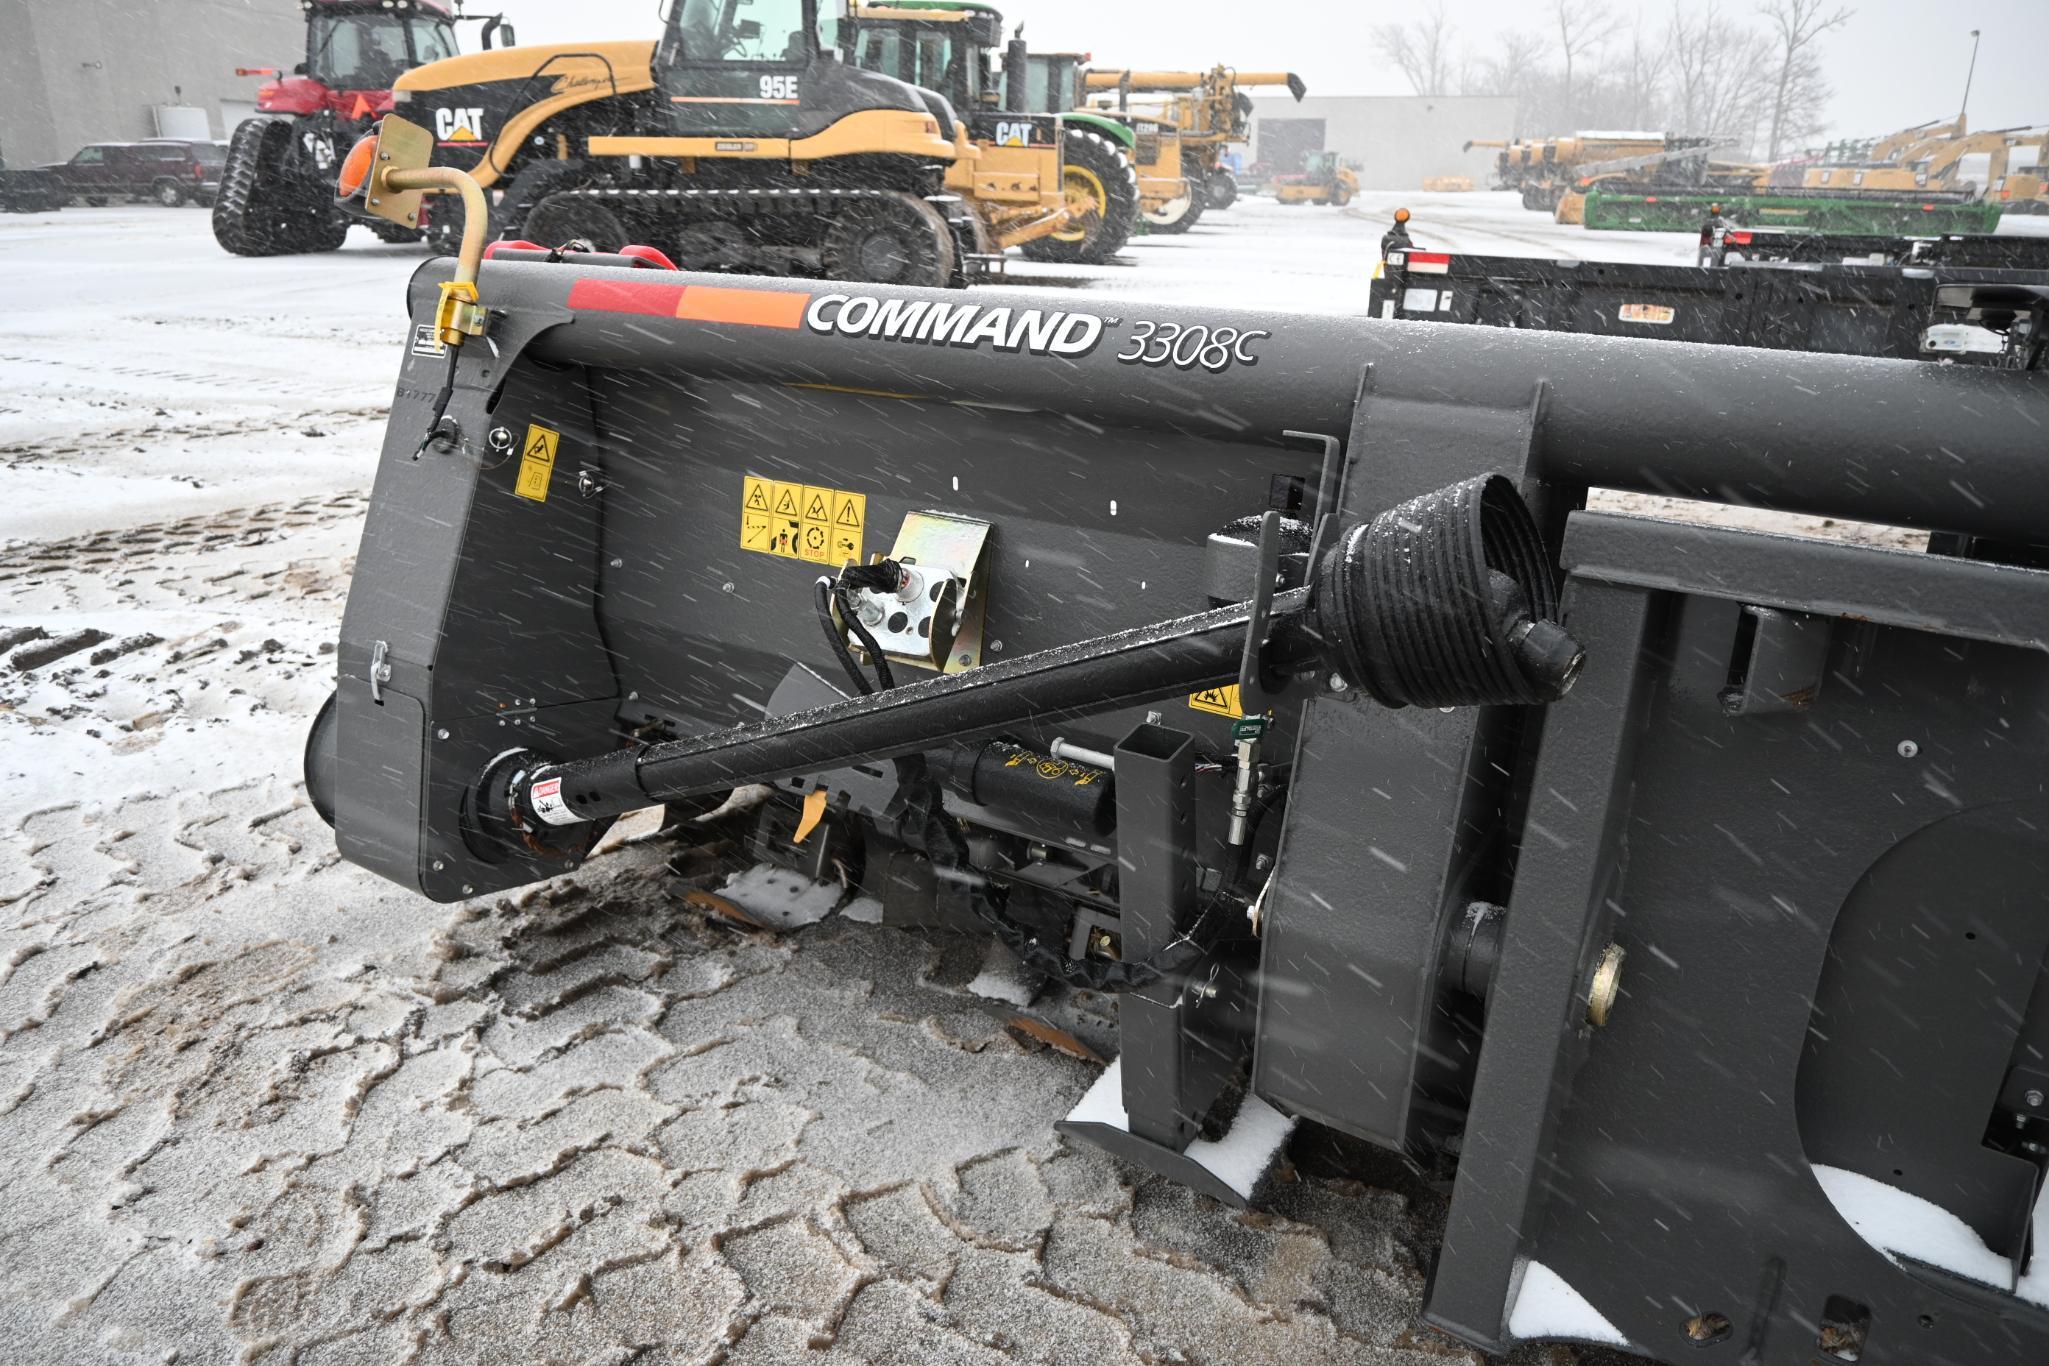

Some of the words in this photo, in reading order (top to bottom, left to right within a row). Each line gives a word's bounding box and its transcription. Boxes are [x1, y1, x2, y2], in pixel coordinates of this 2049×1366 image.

[760, 75, 798, 99] 95E
[435, 107, 484, 141] CAT
[995, 121, 1032, 148] CAT
[1117, 320, 1269, 372] 3308C
[804, 548, 824, 558] STOP
